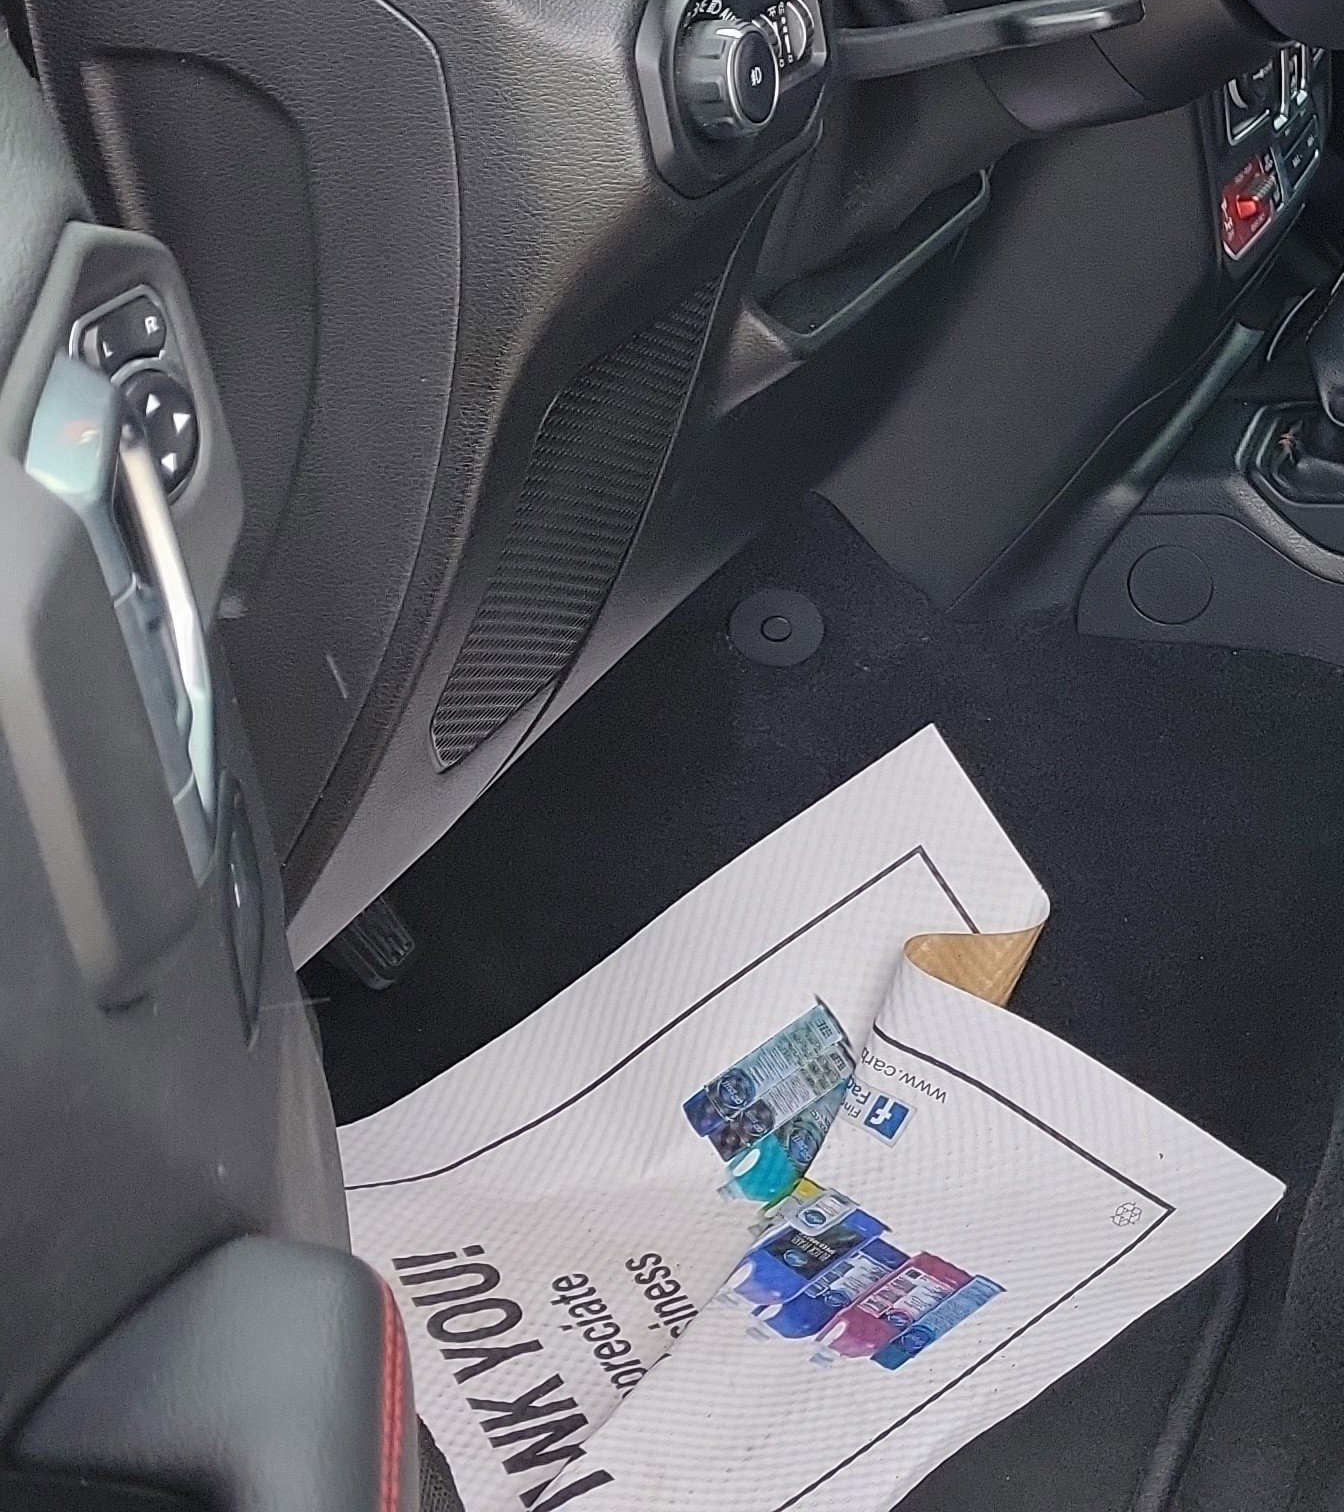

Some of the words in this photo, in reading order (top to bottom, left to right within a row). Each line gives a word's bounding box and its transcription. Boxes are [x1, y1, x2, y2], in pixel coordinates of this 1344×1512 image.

[145, 316, 159, 335] R
[103, 341, 113, 358] L
[391, 1244, 544, 1385] YOU!
